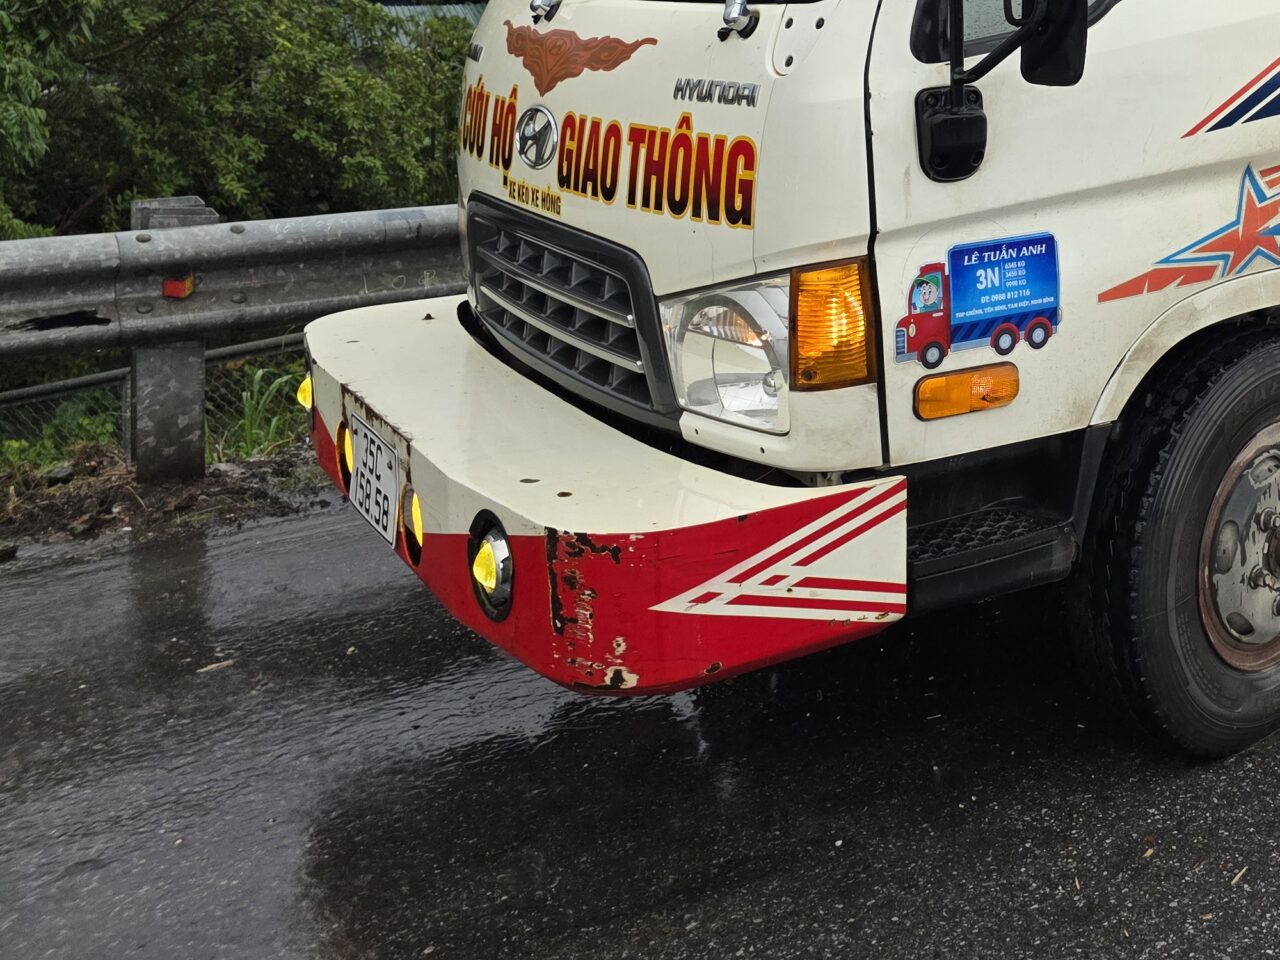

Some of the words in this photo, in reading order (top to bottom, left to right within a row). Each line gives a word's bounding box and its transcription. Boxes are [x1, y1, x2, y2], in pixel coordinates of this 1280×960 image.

[673, 77, 760, 108] HYUNDAI
[462, 74, 491, 161] CỨU
[488, 83, 519, 189] HỘ
[557, 111, 621, 205] GIAO
[627, 111, 757, 230] THÔNG
[508, 181, 517, 200] XE
[517, 180, 530, 205] KÉO
[530, 190, 540, 209] XE
[541, 186, 561, 217] HỎNG
[963, 250, 980, 266] LÊ
[983, 244, 1017, 263] TUẤN
[1019, 243, 1046, 258] ANH
[975, 266, 999, 290] 3N
[991, 292, 1006, 302] 0988
[1006, 291, 1019, 300] 812
[1019, 289, 1030, 298] 116
[362, 431, 383, 481] 35C
[354, 467, 390, 532] 158.58
